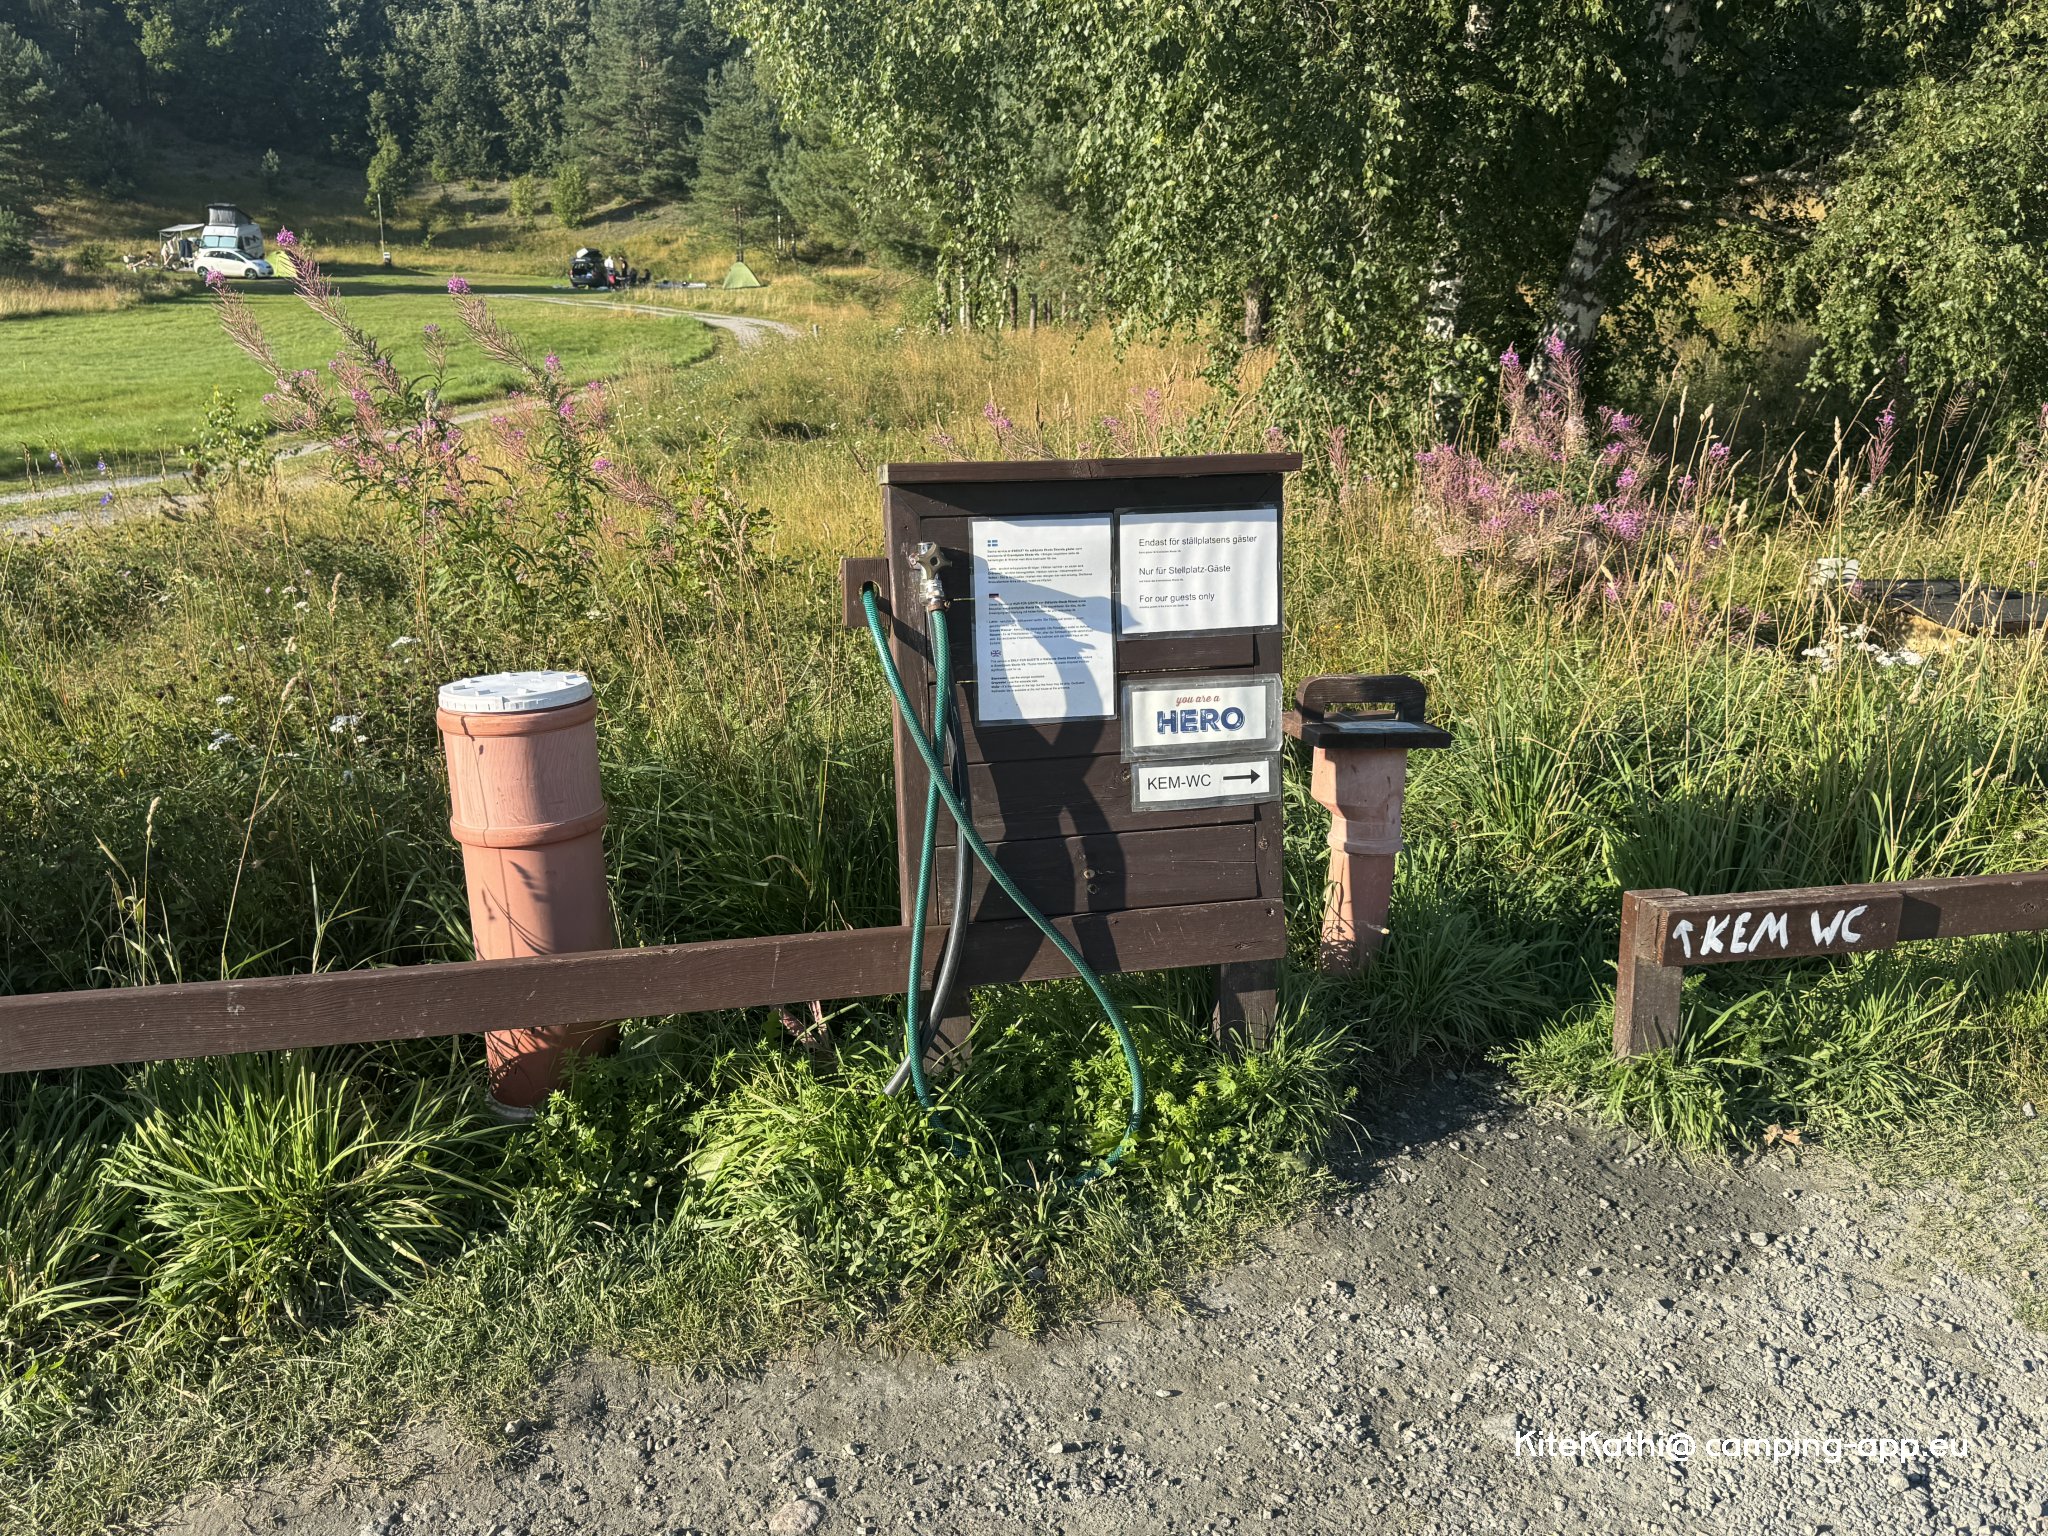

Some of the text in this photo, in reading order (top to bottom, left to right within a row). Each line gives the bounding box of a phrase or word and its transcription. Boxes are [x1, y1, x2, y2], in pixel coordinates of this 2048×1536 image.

[1139, 535, 1257, 547] Endast för ställplatsens gäster
[1139, 564, 1231, 576] Nur für Stellplatz-Gäste
[1139, 592, 1215, 603] For our guests only
[1175, 694, 1220, 707] you are a
[1156, 706, 1246, 735] HERO
[1147, 773, 1211, 791] KEM-WC
[1700, 904, 1868, 956] KEM WC
